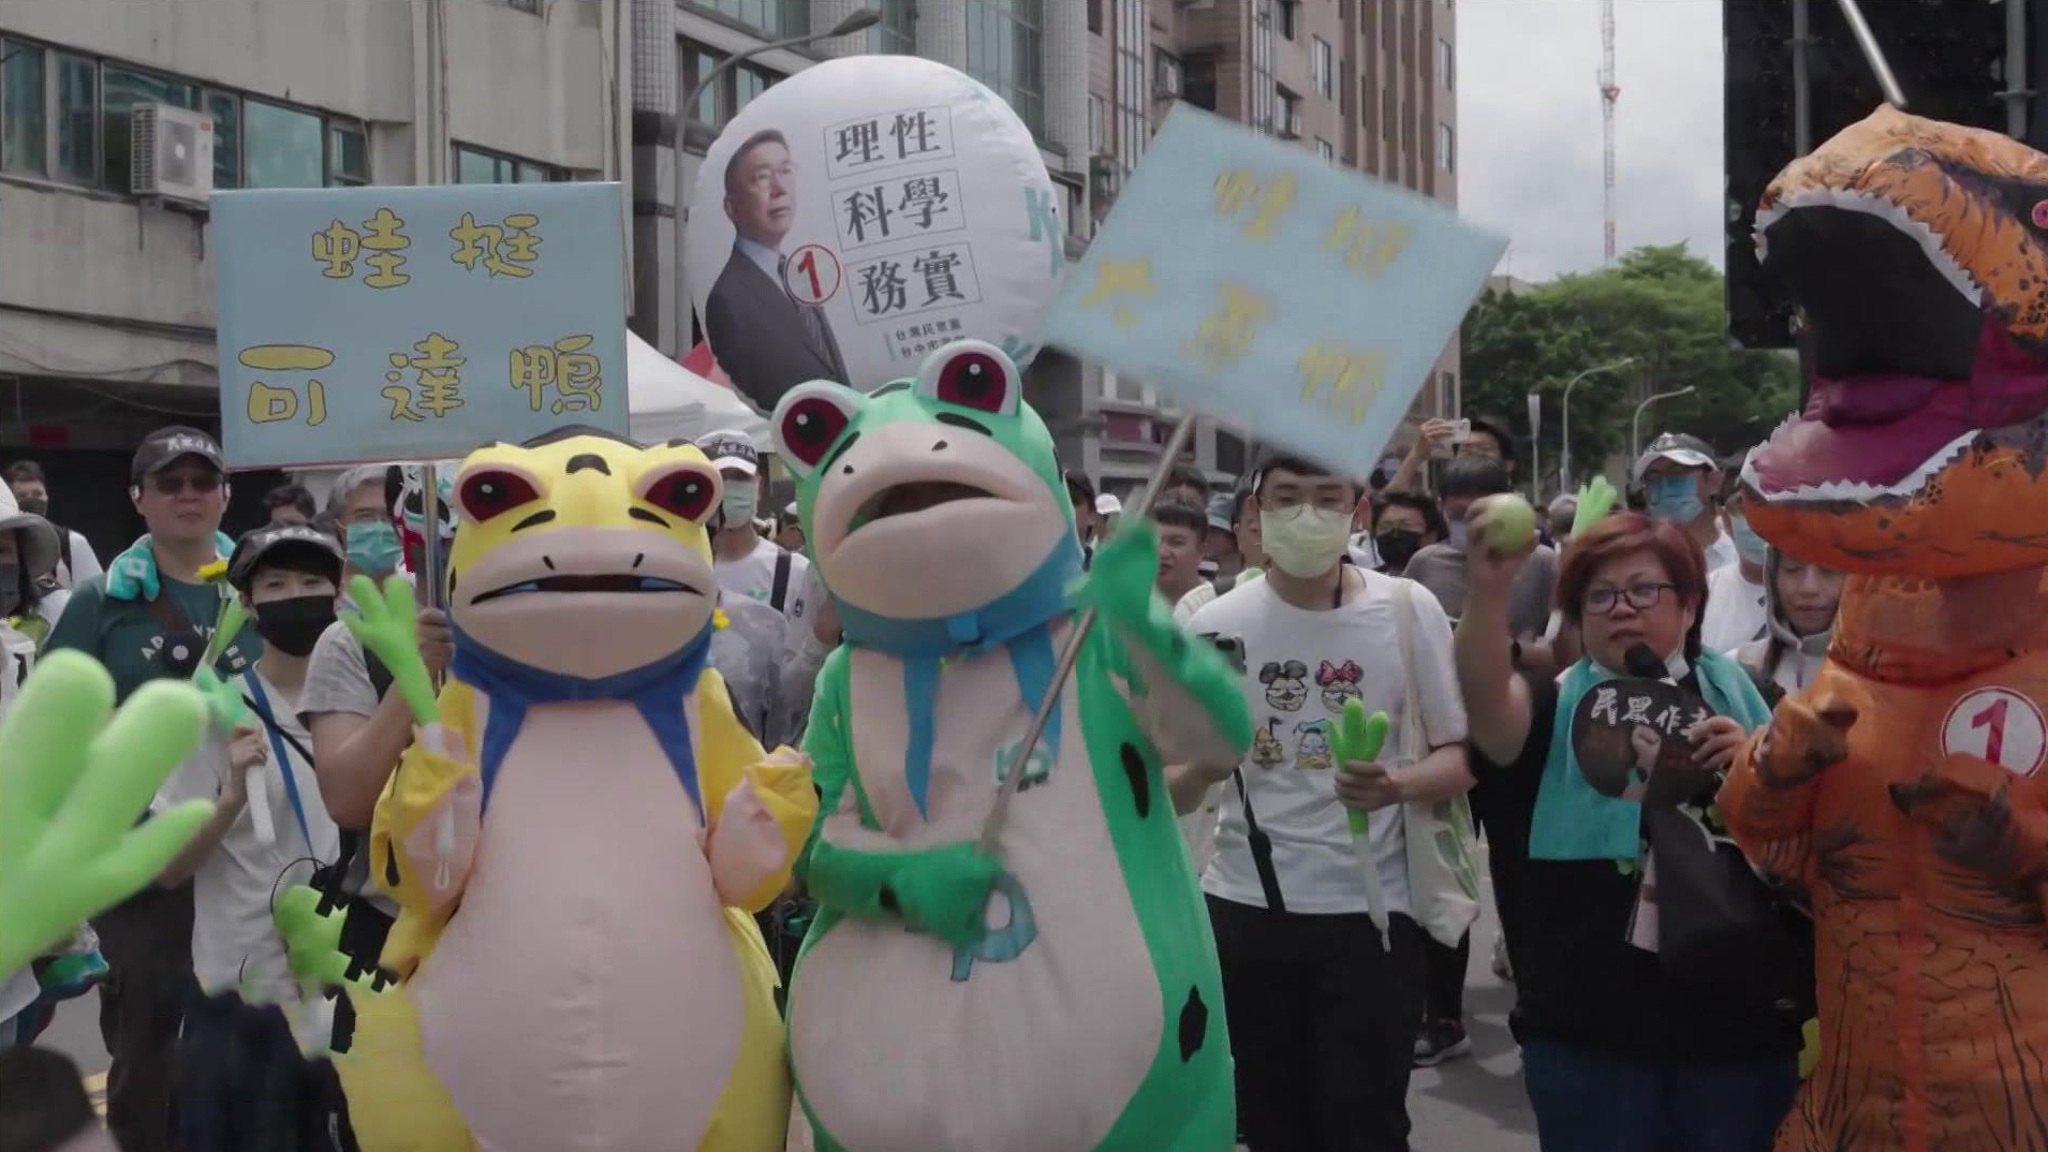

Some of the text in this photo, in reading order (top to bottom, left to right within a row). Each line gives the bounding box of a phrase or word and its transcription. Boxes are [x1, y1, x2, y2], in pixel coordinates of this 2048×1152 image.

[834, 109, 943, 169] 理性
[842, 175, 951, 243] 科學
[311, 207, 544, 289] 蛙挺
[797, 250, 822, 299] 1
[857, 249, 966, 316] 務實
[901, 334, 966, 358] 台中市
[237, 332, 602, 427] 可達鴨
[1971, 698, 2008, 764] 1
